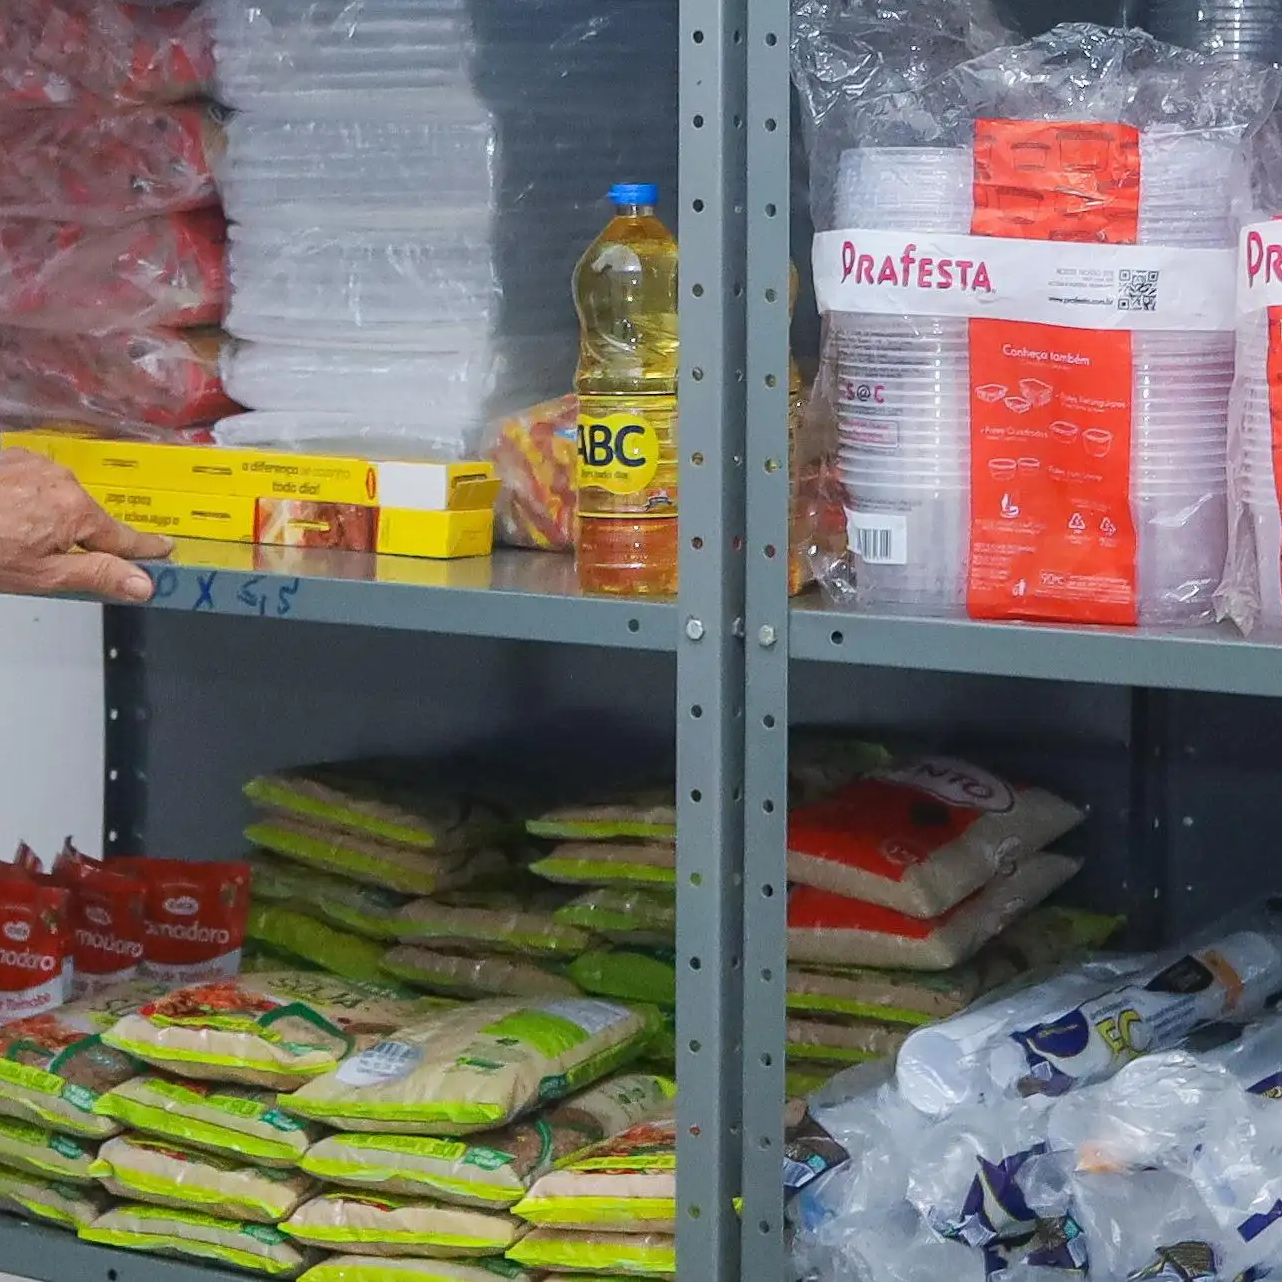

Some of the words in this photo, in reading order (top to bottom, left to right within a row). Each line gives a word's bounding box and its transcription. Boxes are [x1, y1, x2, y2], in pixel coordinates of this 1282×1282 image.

[1003, 343, 1048, 361] Conheça
[1050, 349, 1091, 366] também
[577, 424, 646, 467] ABC
